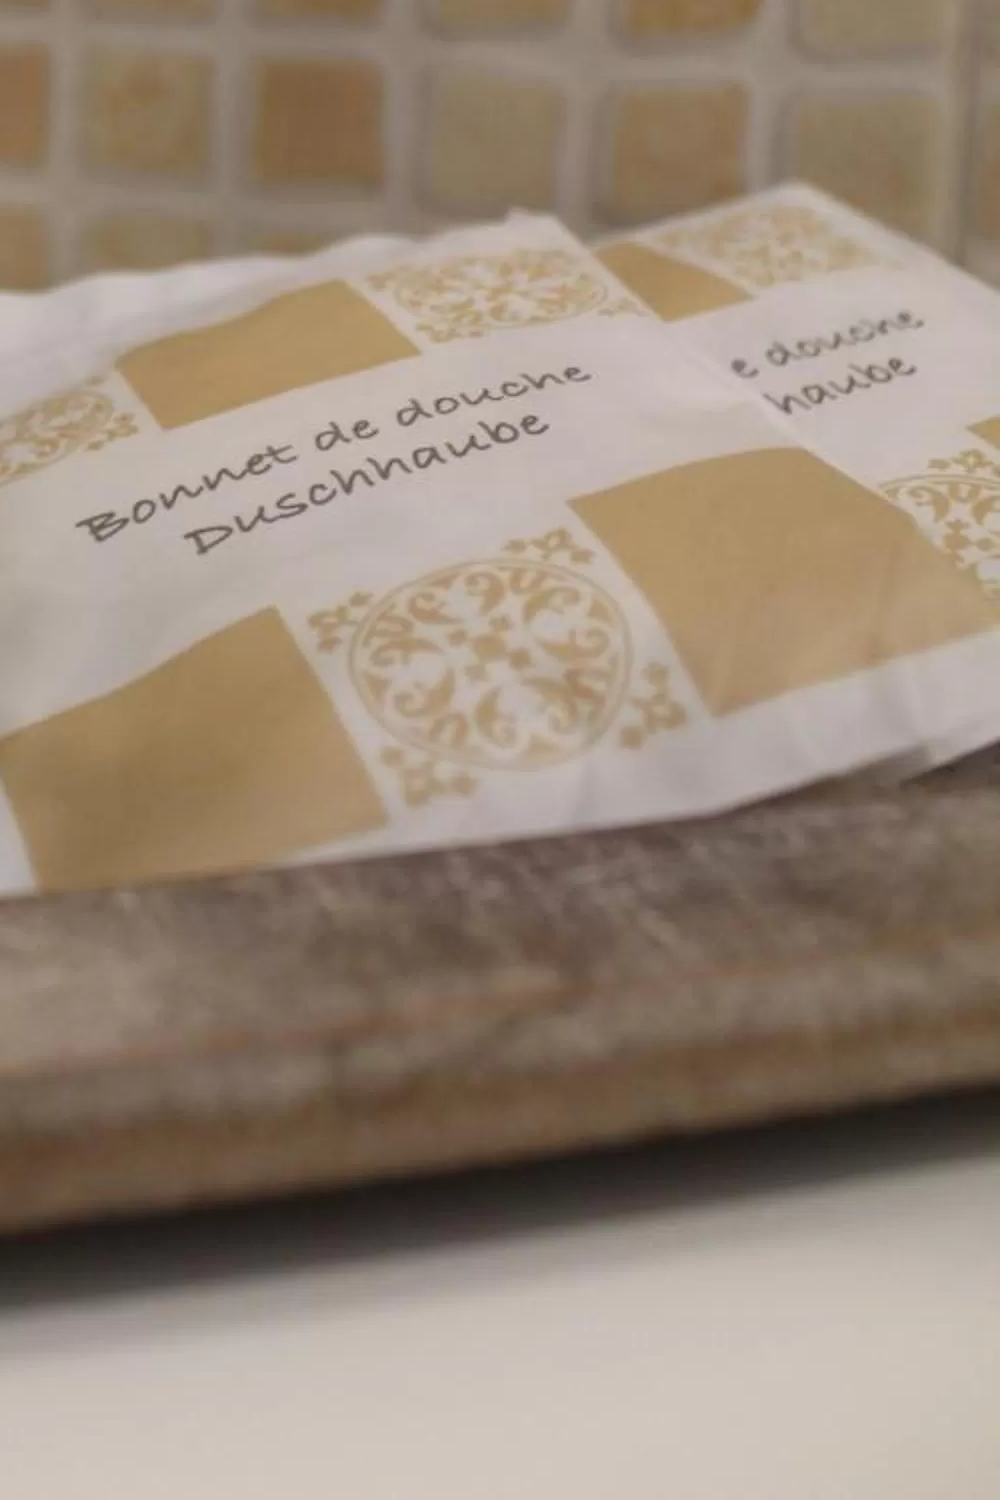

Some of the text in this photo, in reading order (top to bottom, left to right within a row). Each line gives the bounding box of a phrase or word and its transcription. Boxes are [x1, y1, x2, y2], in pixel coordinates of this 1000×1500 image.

[731, 311, 924, 379] e douche
[763, 357, 917, 415] haube
[75, 362, 593, 542] Bonnet de douche
[183, 410, 551, 556] Duschhaube
